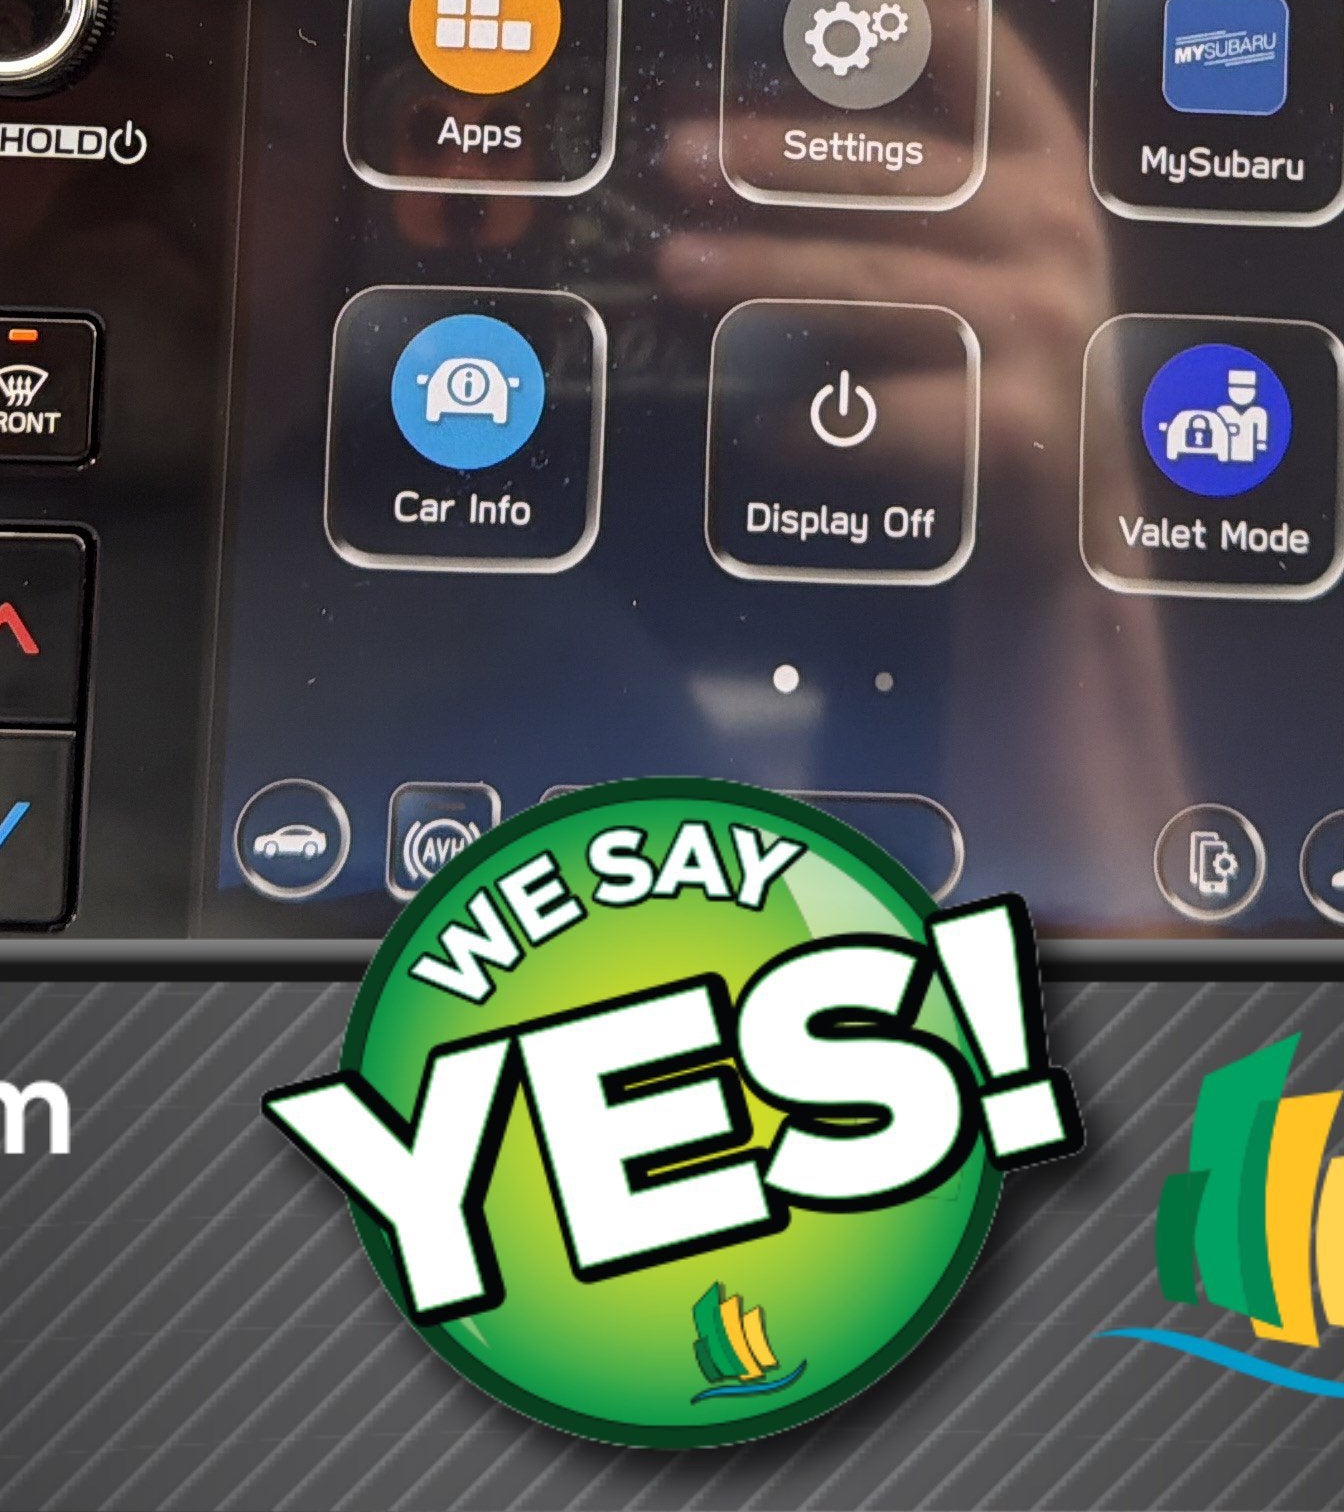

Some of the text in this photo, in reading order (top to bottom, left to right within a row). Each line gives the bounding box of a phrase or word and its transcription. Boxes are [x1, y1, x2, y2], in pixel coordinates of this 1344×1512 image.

[437, 117, 522, 154] Apps
[783, 130, 924, 170] Settings
[1141, 146, 1304, 183] MySubaru
[394, 491, 532, 527] Car Info
[746, 502, 935, 544] Display Off
[1117, 516, 1310, 555] Valet Mode
